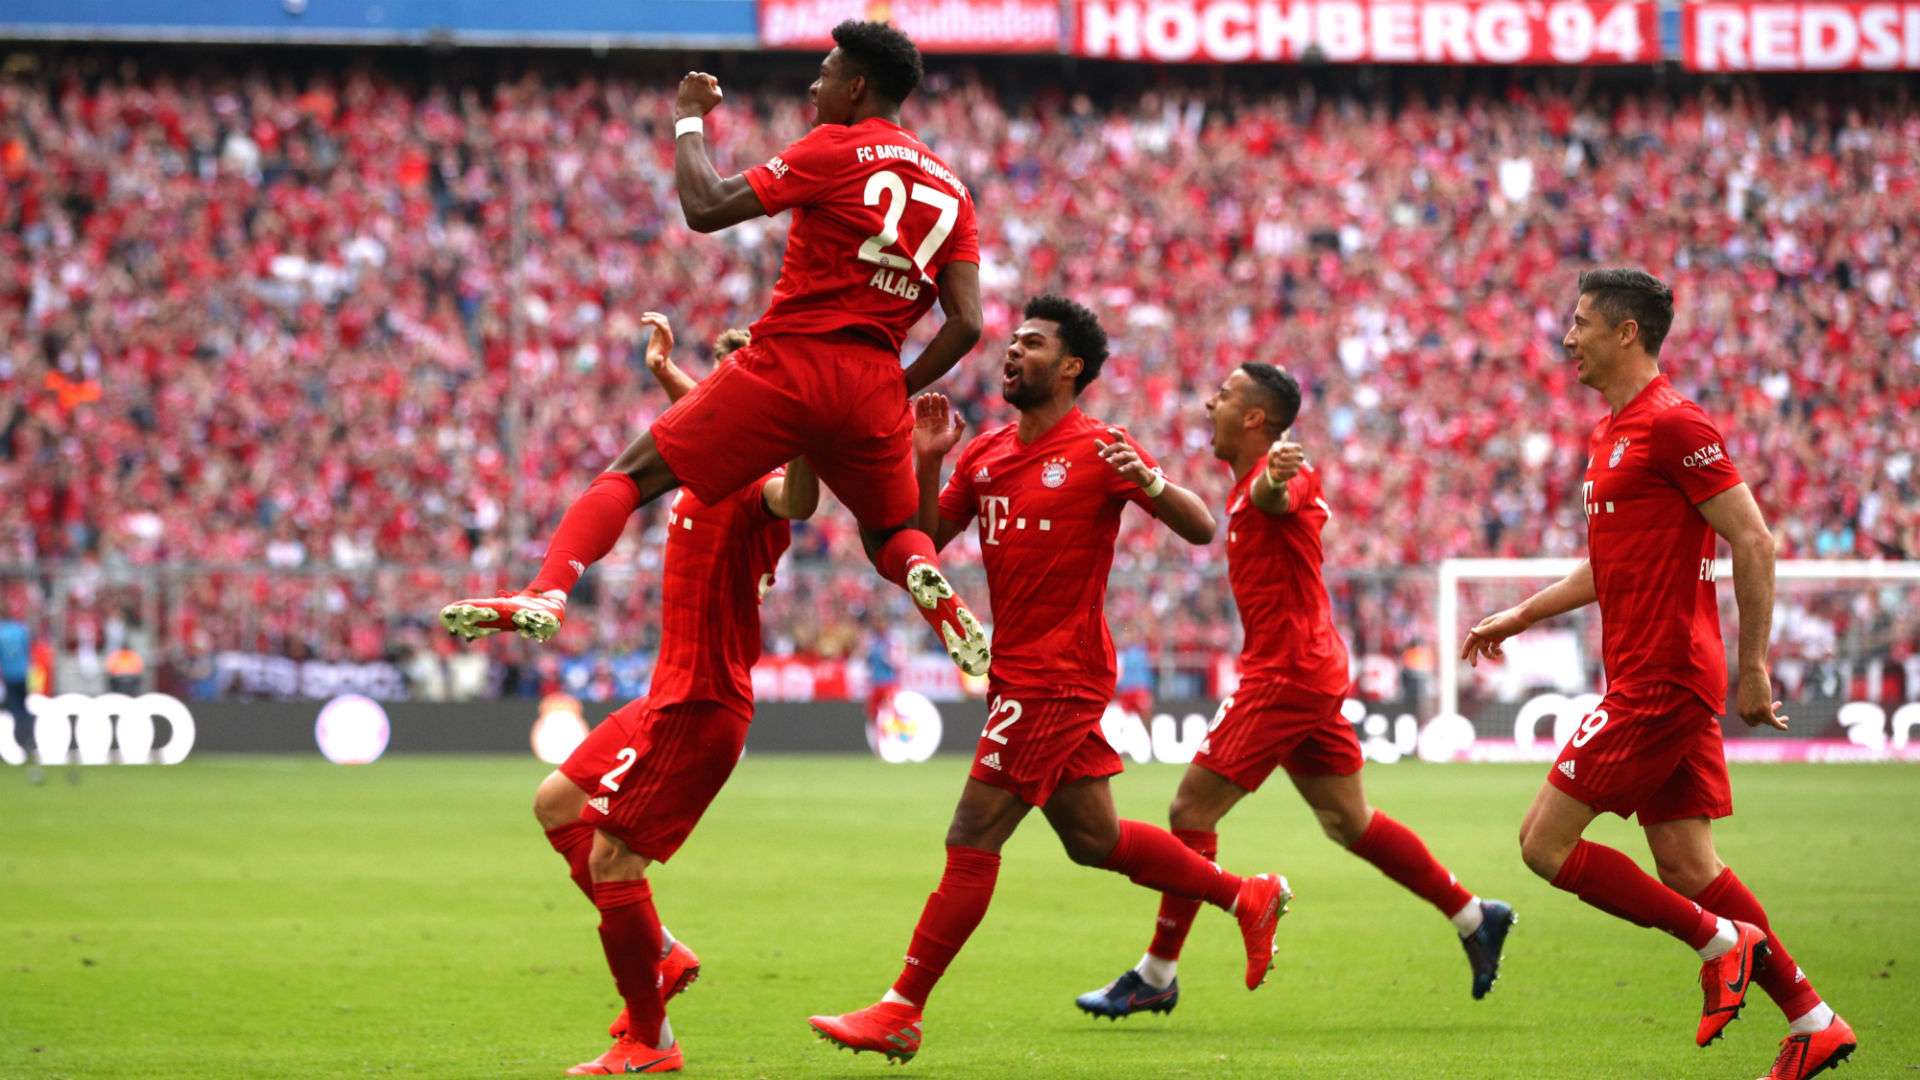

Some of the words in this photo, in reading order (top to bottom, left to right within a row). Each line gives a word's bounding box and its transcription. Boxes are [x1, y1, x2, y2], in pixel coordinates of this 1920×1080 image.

[856, 146, 874, 163] FC
[875, 144, 919, 166] BAYERN
[857, 170, 960, 273] 27
[1683, 441, 1720, 467] QATAR
[981, 694, 1023, 745] 22
[1572, 710, 1609, 748] 9
[600, 747, 637, 792] 2
